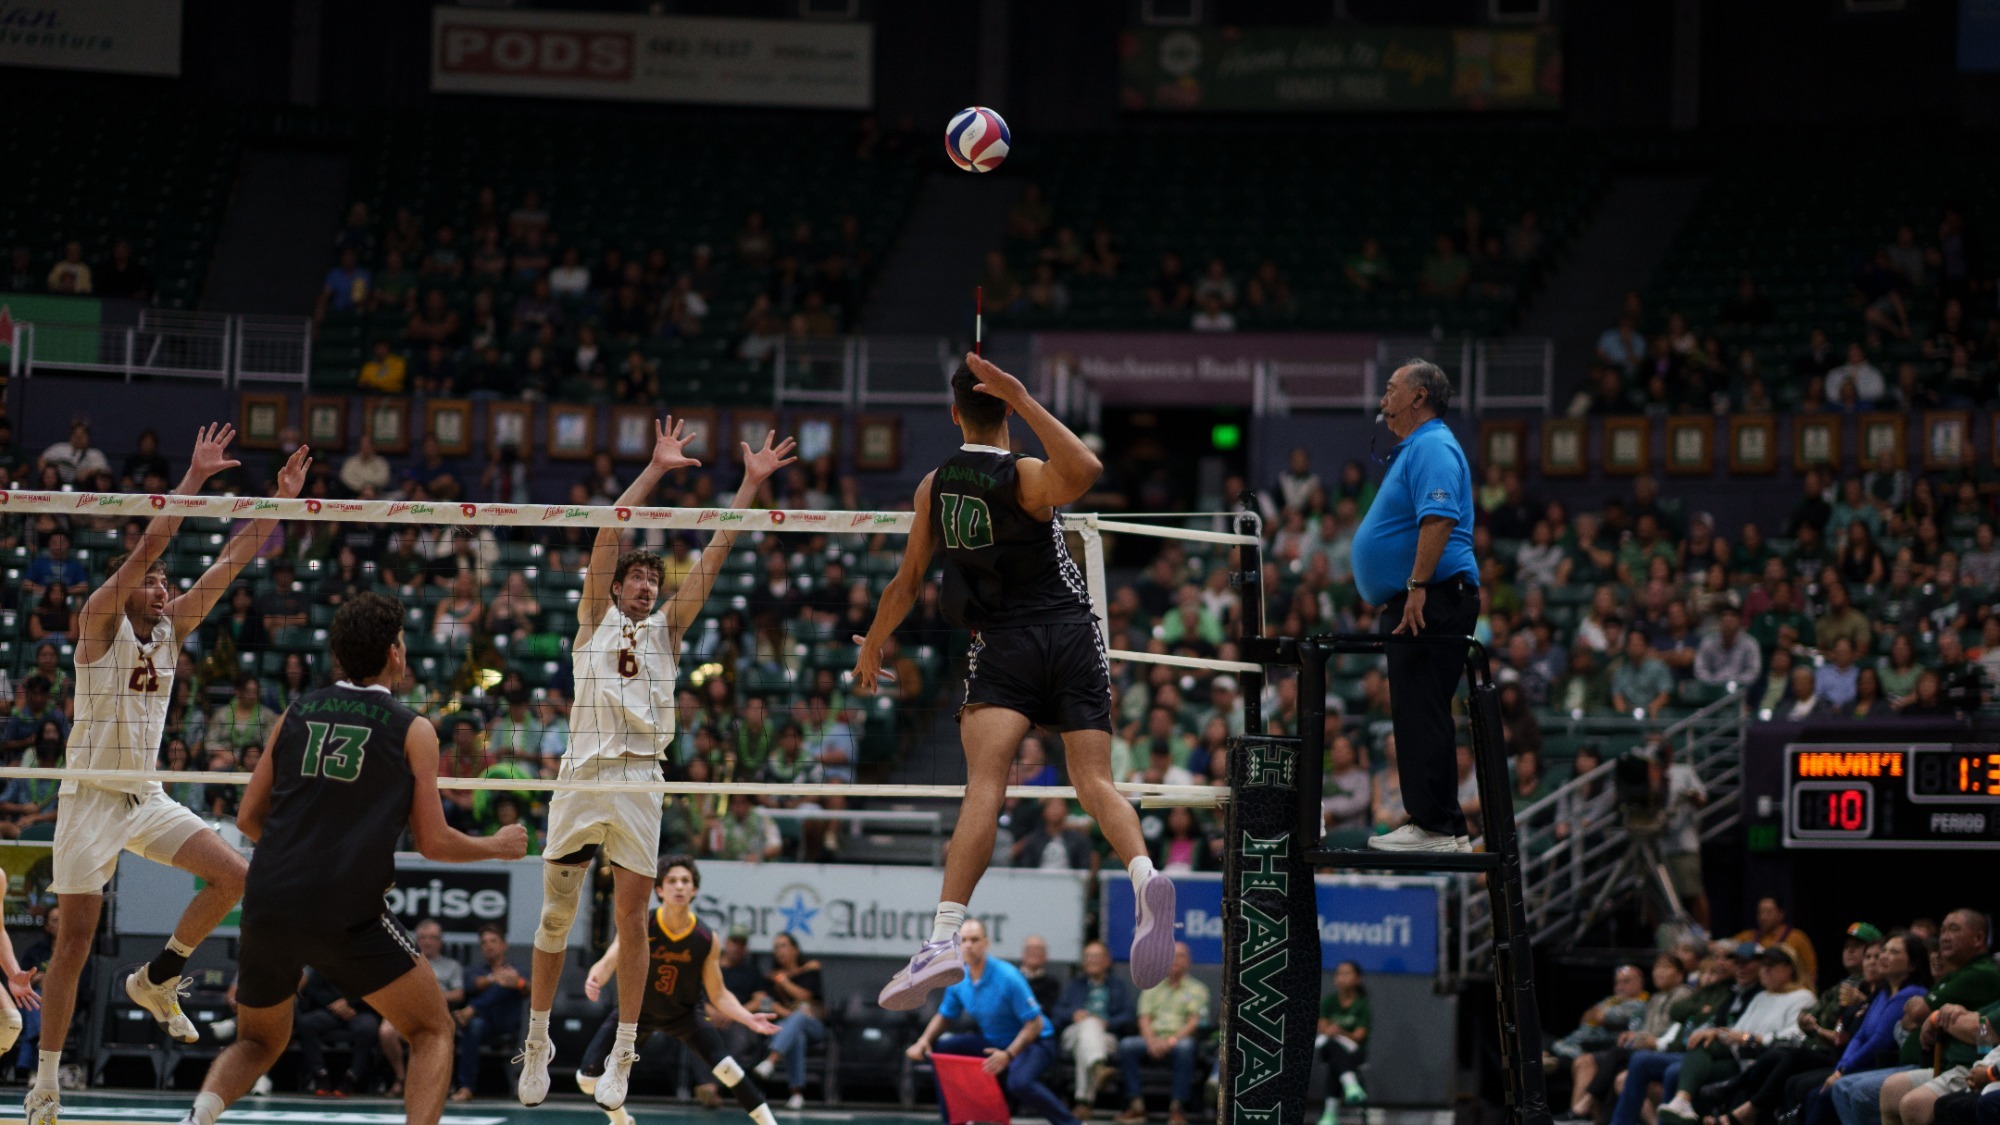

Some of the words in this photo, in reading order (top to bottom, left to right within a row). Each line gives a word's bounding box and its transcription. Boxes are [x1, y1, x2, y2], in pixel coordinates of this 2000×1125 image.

[446, 28, 627, 76] PODS
[940, 493, 994, 550] 10
[618, 648, 638, 678] 6
[301, 721, 373, 782] 13
[1828, 789, 1864, 830] 10
[1930, 812, 1986, 833] PERIOD
[695, 894, 775, 936] Star
[655, 964, 679, 995] 3
